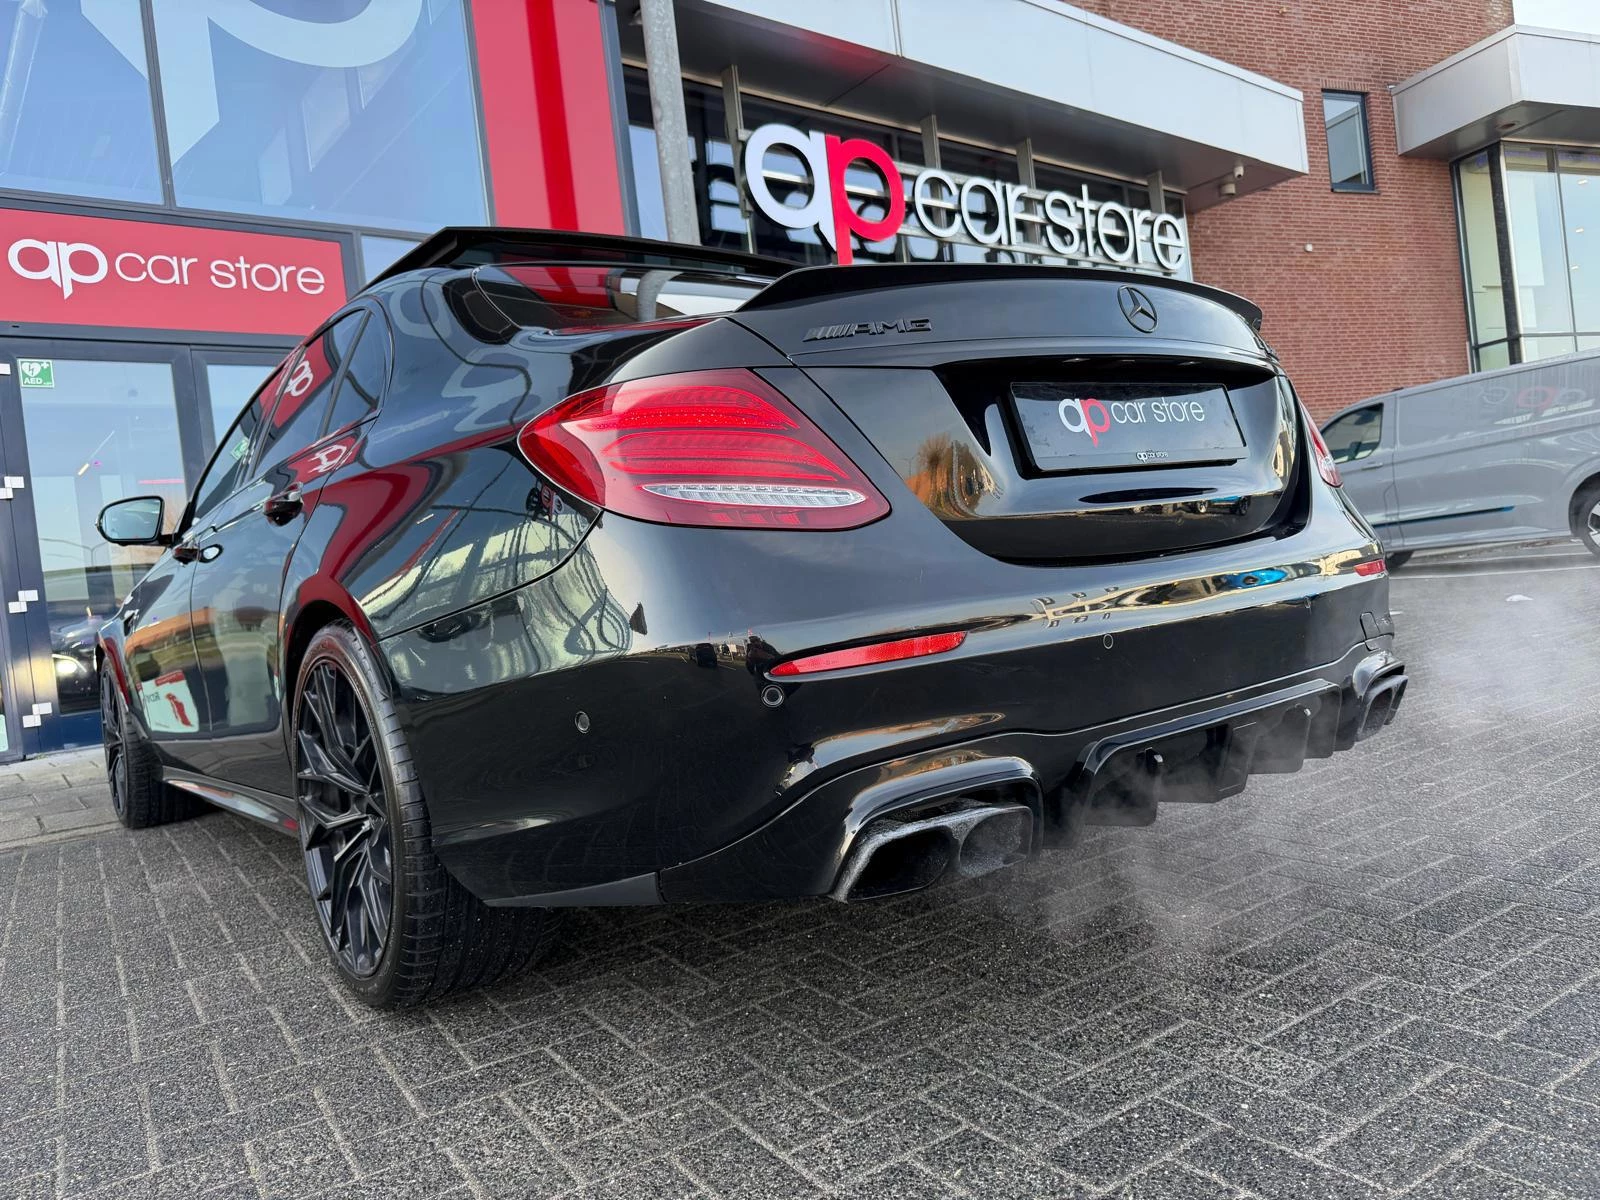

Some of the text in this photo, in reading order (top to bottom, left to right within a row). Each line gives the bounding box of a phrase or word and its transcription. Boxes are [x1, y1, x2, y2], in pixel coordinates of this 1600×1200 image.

[744, 123, 1186, 271] ap car store
[7, 238, 326, 300] ap car store
[846, 318, 931, 336] AMG
[24, 377, 43, 385] AED
[1058, 396, 1205, 448] ap car store
